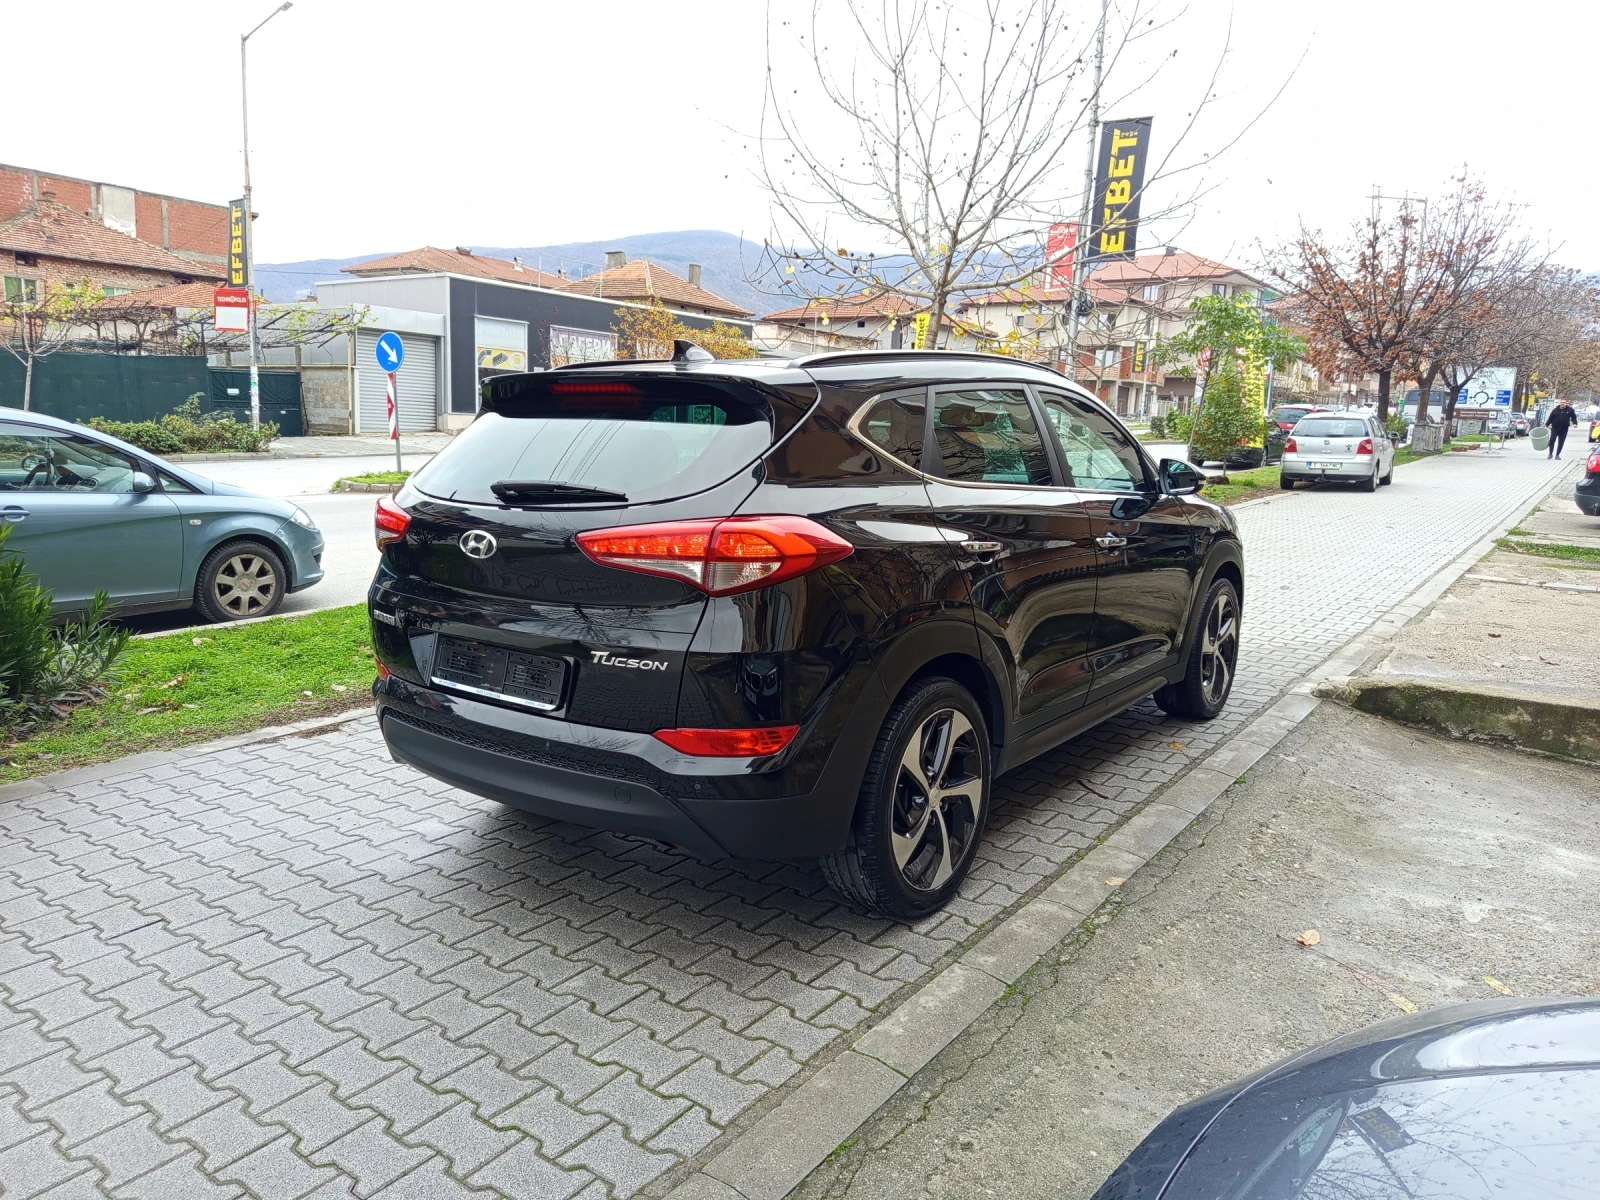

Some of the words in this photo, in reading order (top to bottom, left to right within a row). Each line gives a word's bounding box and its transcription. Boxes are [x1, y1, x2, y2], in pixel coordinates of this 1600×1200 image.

[1100, 128, 1138, 254] EFBET
[231, 205, 244, 285] EFBET
[216, 295, 247, 303] TECHNOPOLIS
[590, 650, 669, 671] TUCSON
